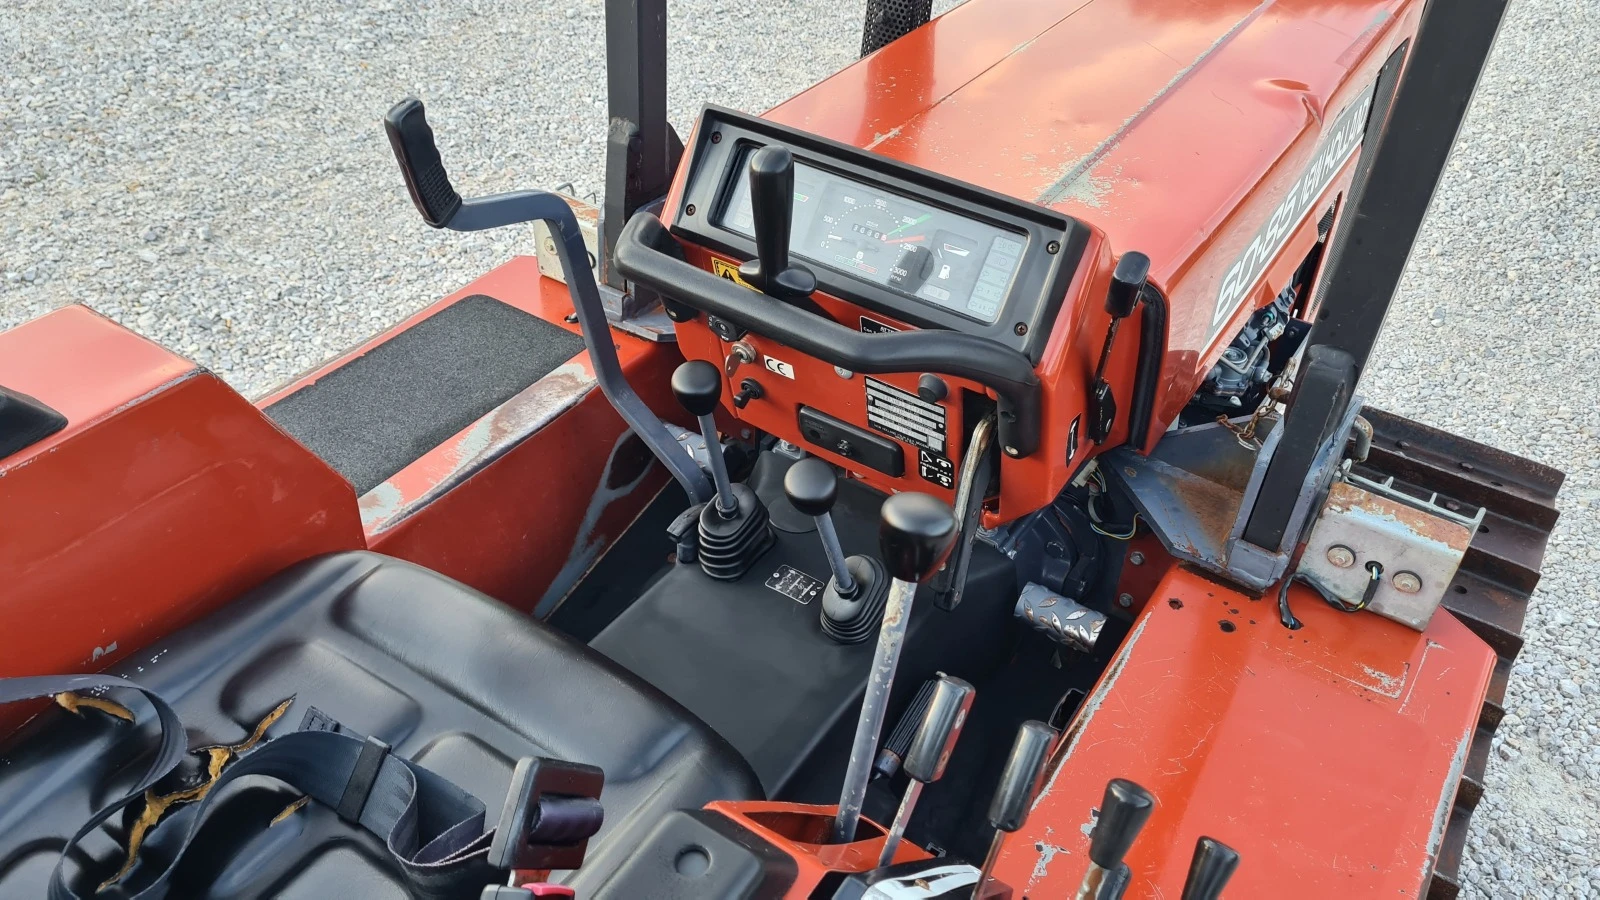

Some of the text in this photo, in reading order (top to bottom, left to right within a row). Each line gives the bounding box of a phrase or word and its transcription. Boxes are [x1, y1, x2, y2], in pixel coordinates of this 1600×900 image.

[1297, 154, 1323, 212] NEW
[1321, 97, 1370, 181] HOLLAND
[824, 215, 834, 224] 500
[903, 243, 917, 253] 2500
[893, 267, 907, 277] 3000
[766, 358, 786, 376] CE
